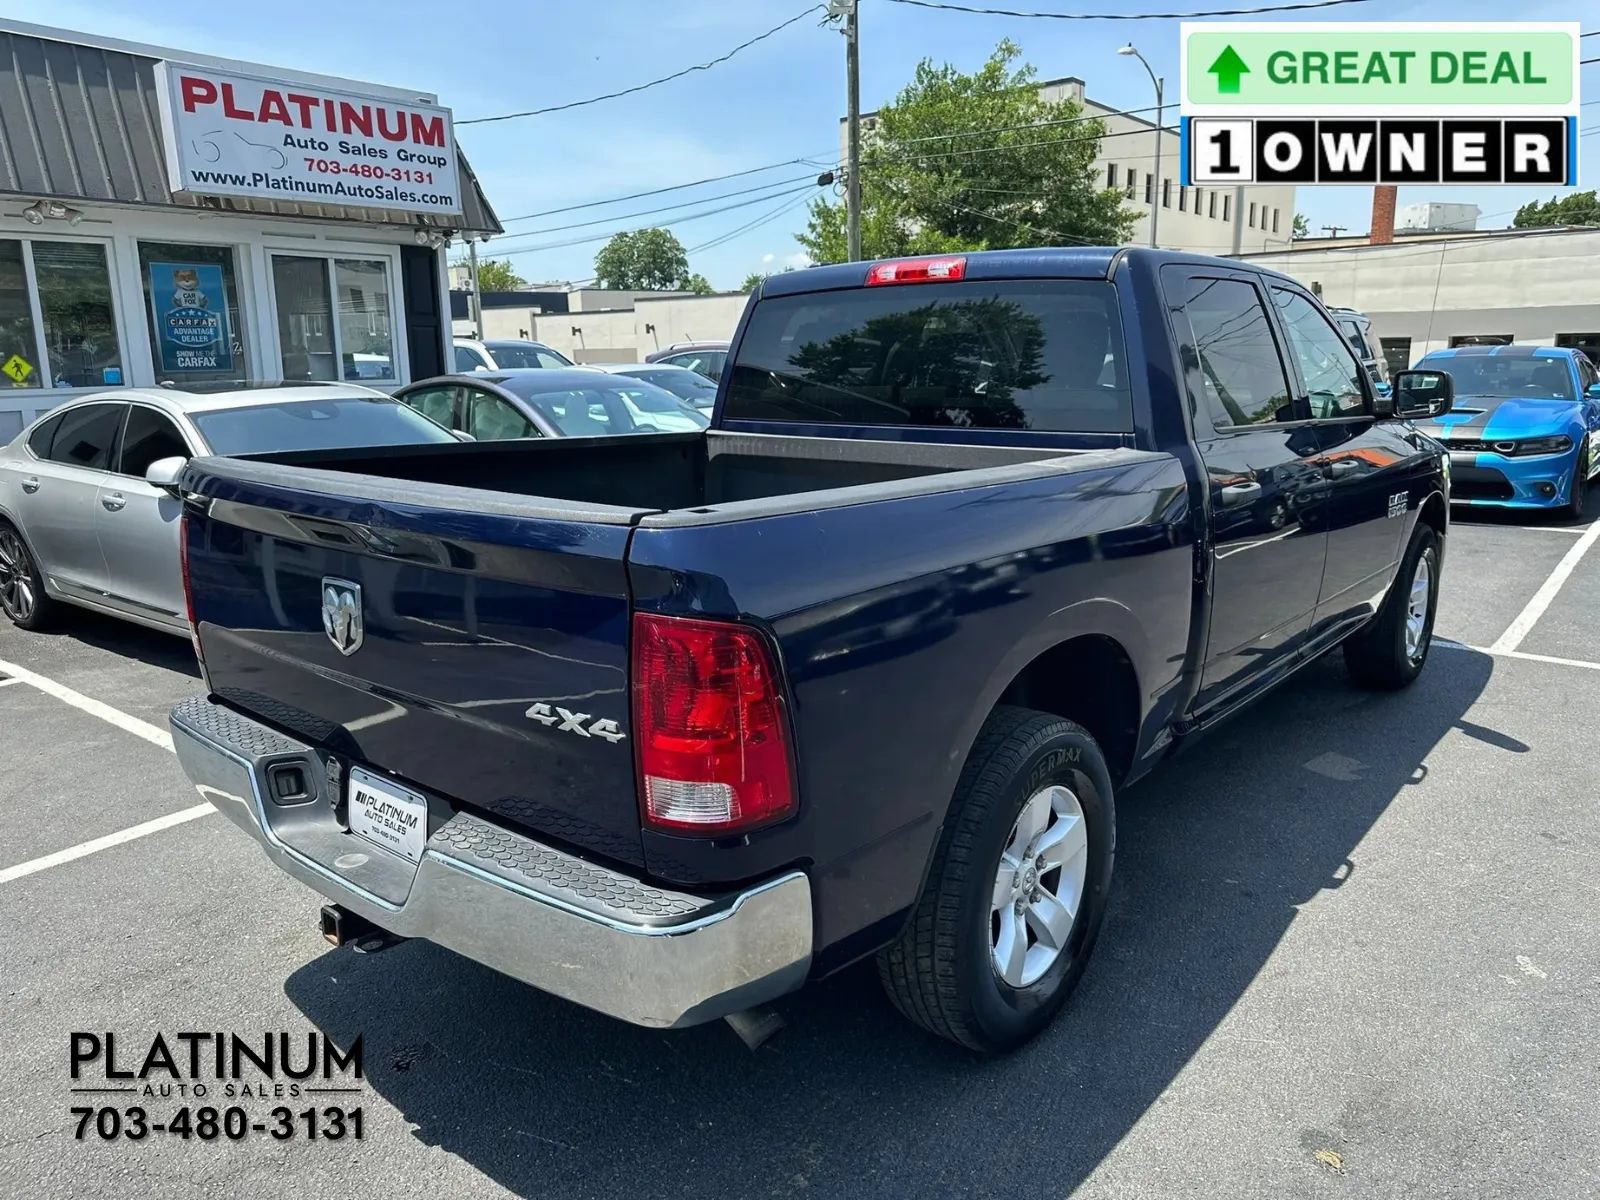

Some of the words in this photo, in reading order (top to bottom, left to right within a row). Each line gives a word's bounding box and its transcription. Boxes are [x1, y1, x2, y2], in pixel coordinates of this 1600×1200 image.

[180, 76, 446, 148] PLATINUM
[283, 134, 329, 152] Auto
[338, 141, 388, 159] Sales
[396, 150, 447, 168] Group
[303, 158, 434, 185] 703-480-3131
[191, 170, 453, 206] www.PlatinumAutoSales.com
[170, 318, 217, 327] CARFAX
[174, 327, 215, 336] ADVANTAGE
[181, 335, 209, 343] DEALER
[176, 350, 195, 358] SHOW
[177, 357, 217, 367] CARFAX
[364, 809, 383, 824] AUTO
[384, 818, 407, 836] SALES
[365, 796, 418, 830] PLATINUM
